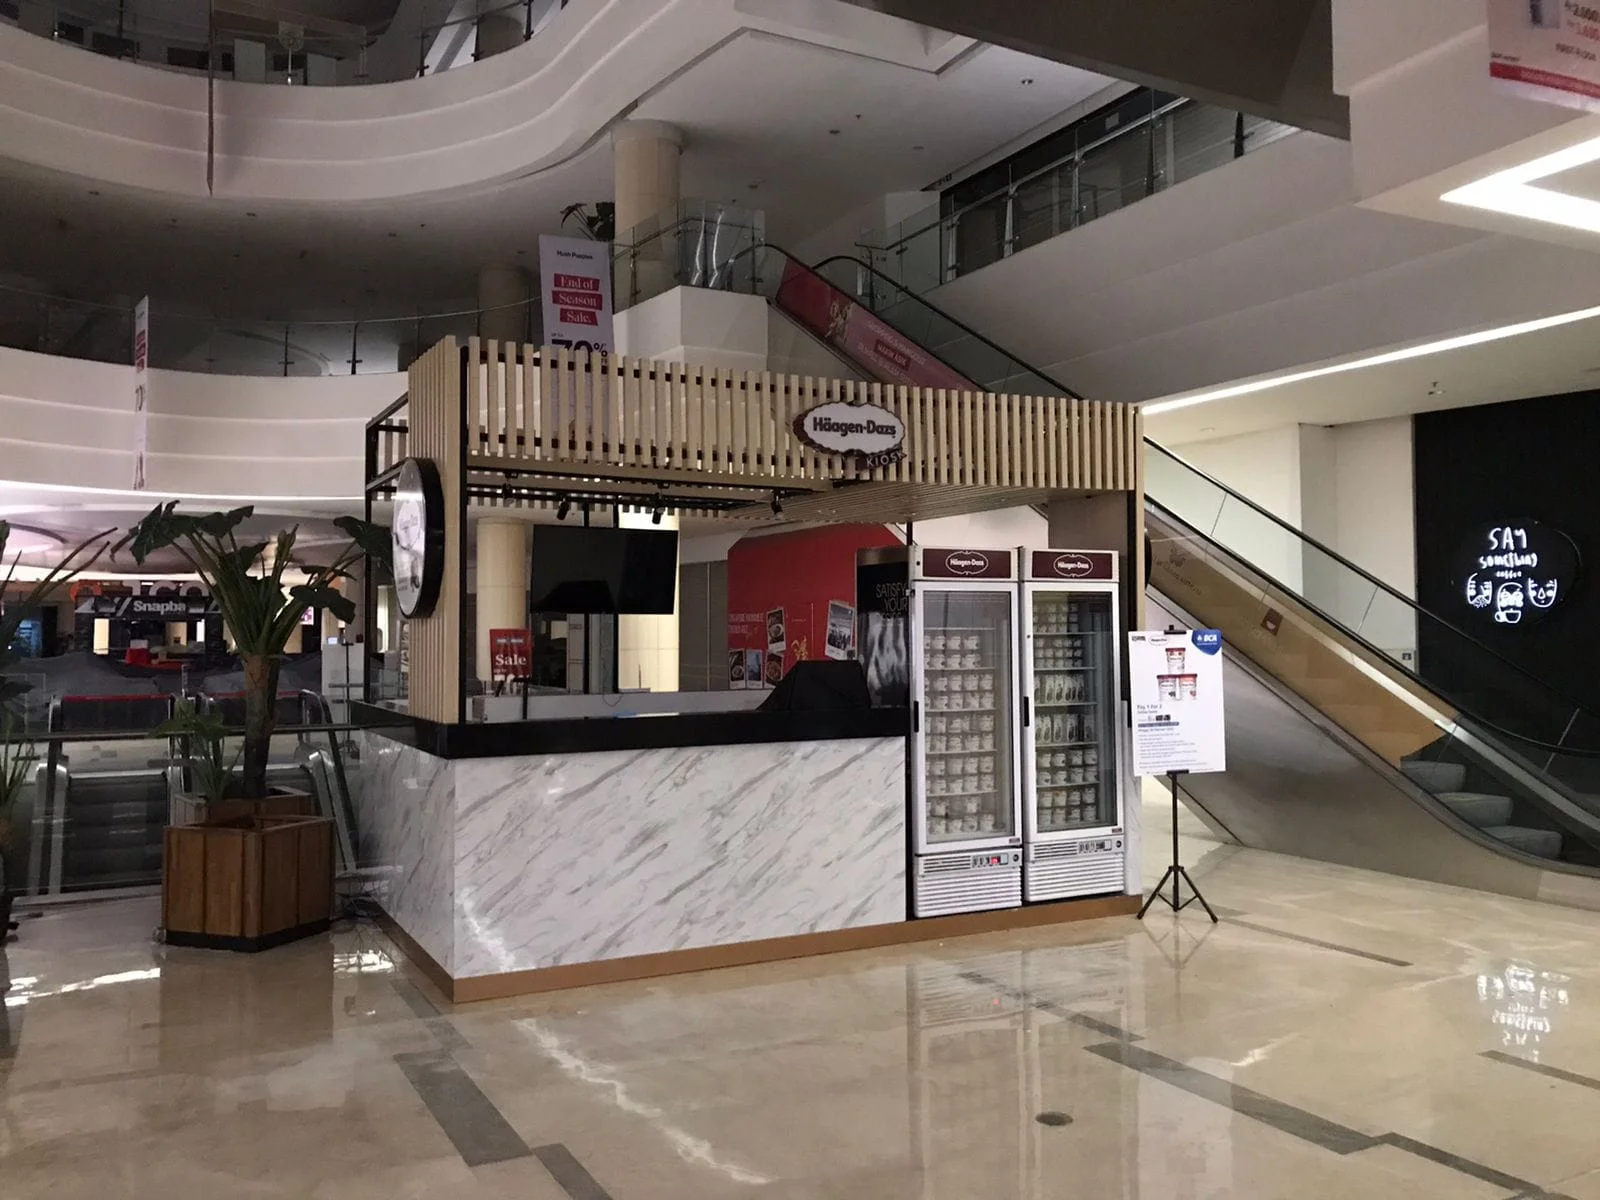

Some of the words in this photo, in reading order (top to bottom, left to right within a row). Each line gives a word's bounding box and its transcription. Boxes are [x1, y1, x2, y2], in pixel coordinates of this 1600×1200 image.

[560, 276, 581, 289] End
[581, 279, 594, 289] of
[559, 293, 597, 307] Season
[813, 417, 896, 437] Häagen-Dazs
[1489, 526, 1527, 550] SAY
[884, 597, 909, 611] YOUR
[495, 654, 527, 666] Sale
